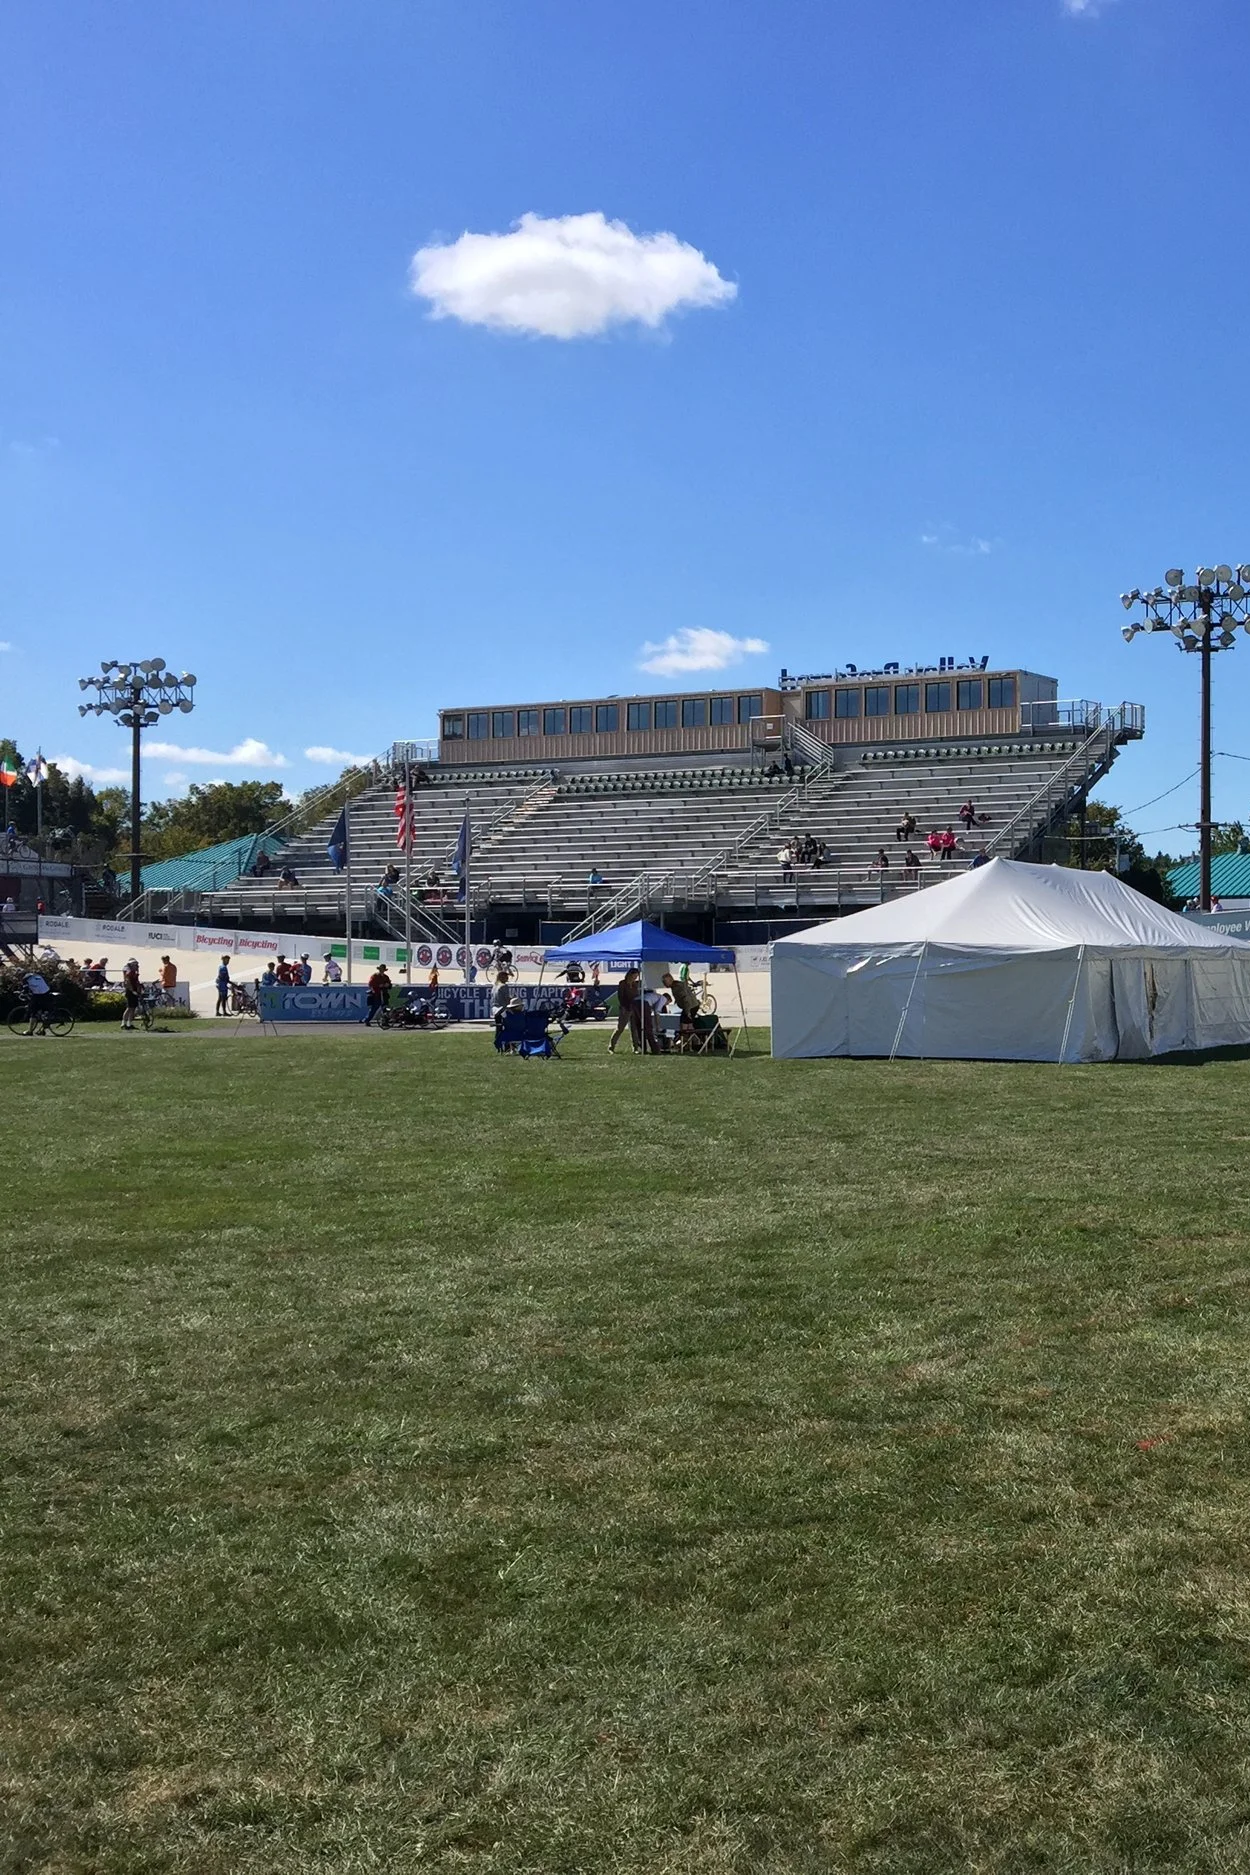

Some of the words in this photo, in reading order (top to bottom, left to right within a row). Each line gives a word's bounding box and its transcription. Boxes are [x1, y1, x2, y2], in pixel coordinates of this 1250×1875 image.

[196, 934, 234, 947] Bicycling
[238, 938, 278, 951] Bicycling
[610, 960, 632, 968] LIGHT
[282, 992, 362, 1009] TOWN
